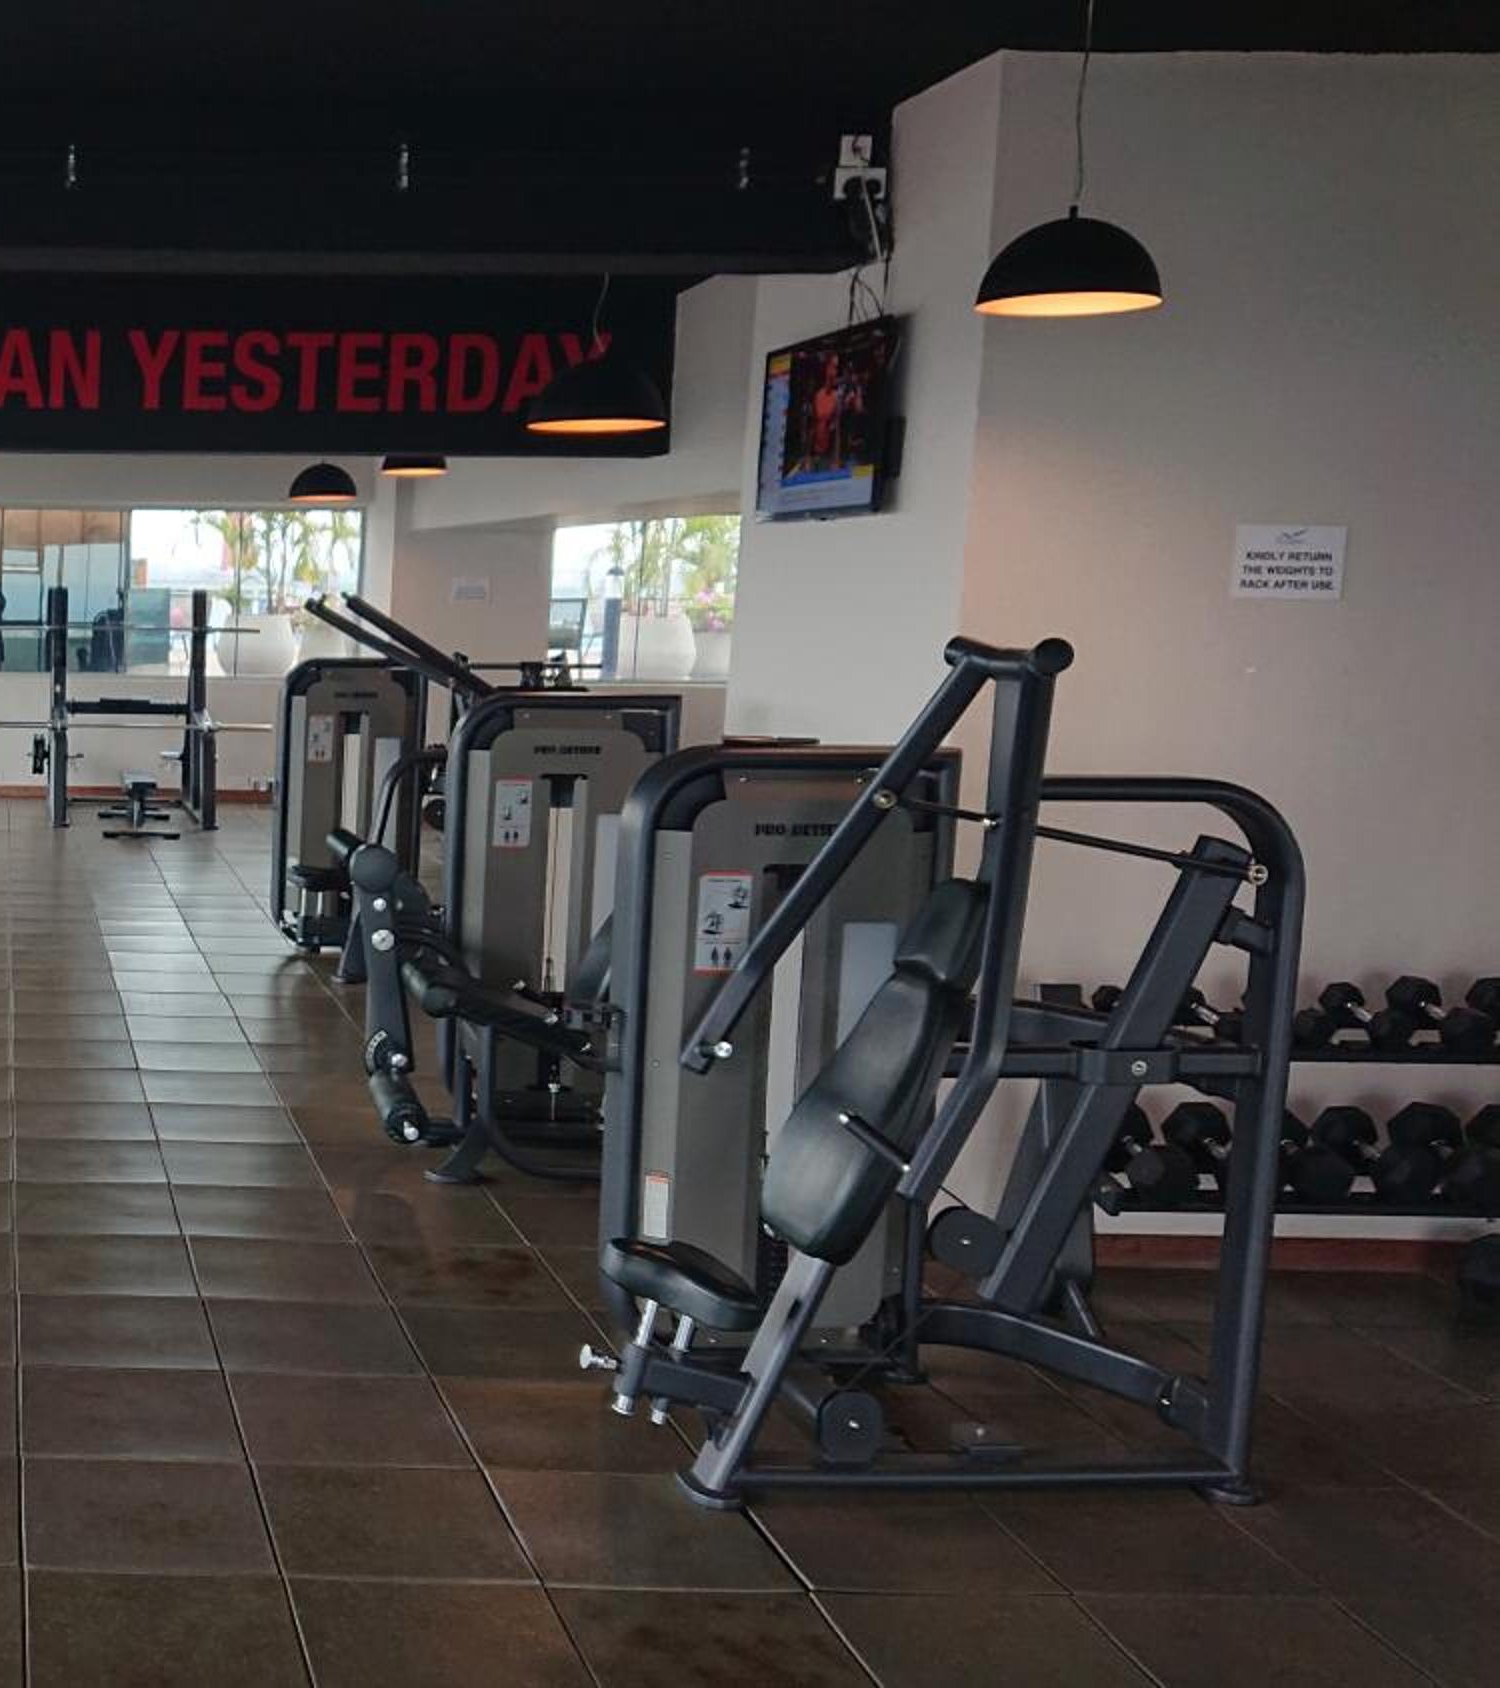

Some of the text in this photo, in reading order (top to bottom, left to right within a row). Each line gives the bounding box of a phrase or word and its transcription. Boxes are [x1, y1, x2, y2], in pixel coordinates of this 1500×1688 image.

[1245, 551, 1333, 562] KINDLY RETURN
[1243, 565, 1333, 576] THE WEIGHTS TO
[1239, 579, 1269, 589] RACK
[1273, 579, 1309, 590] AFTER
